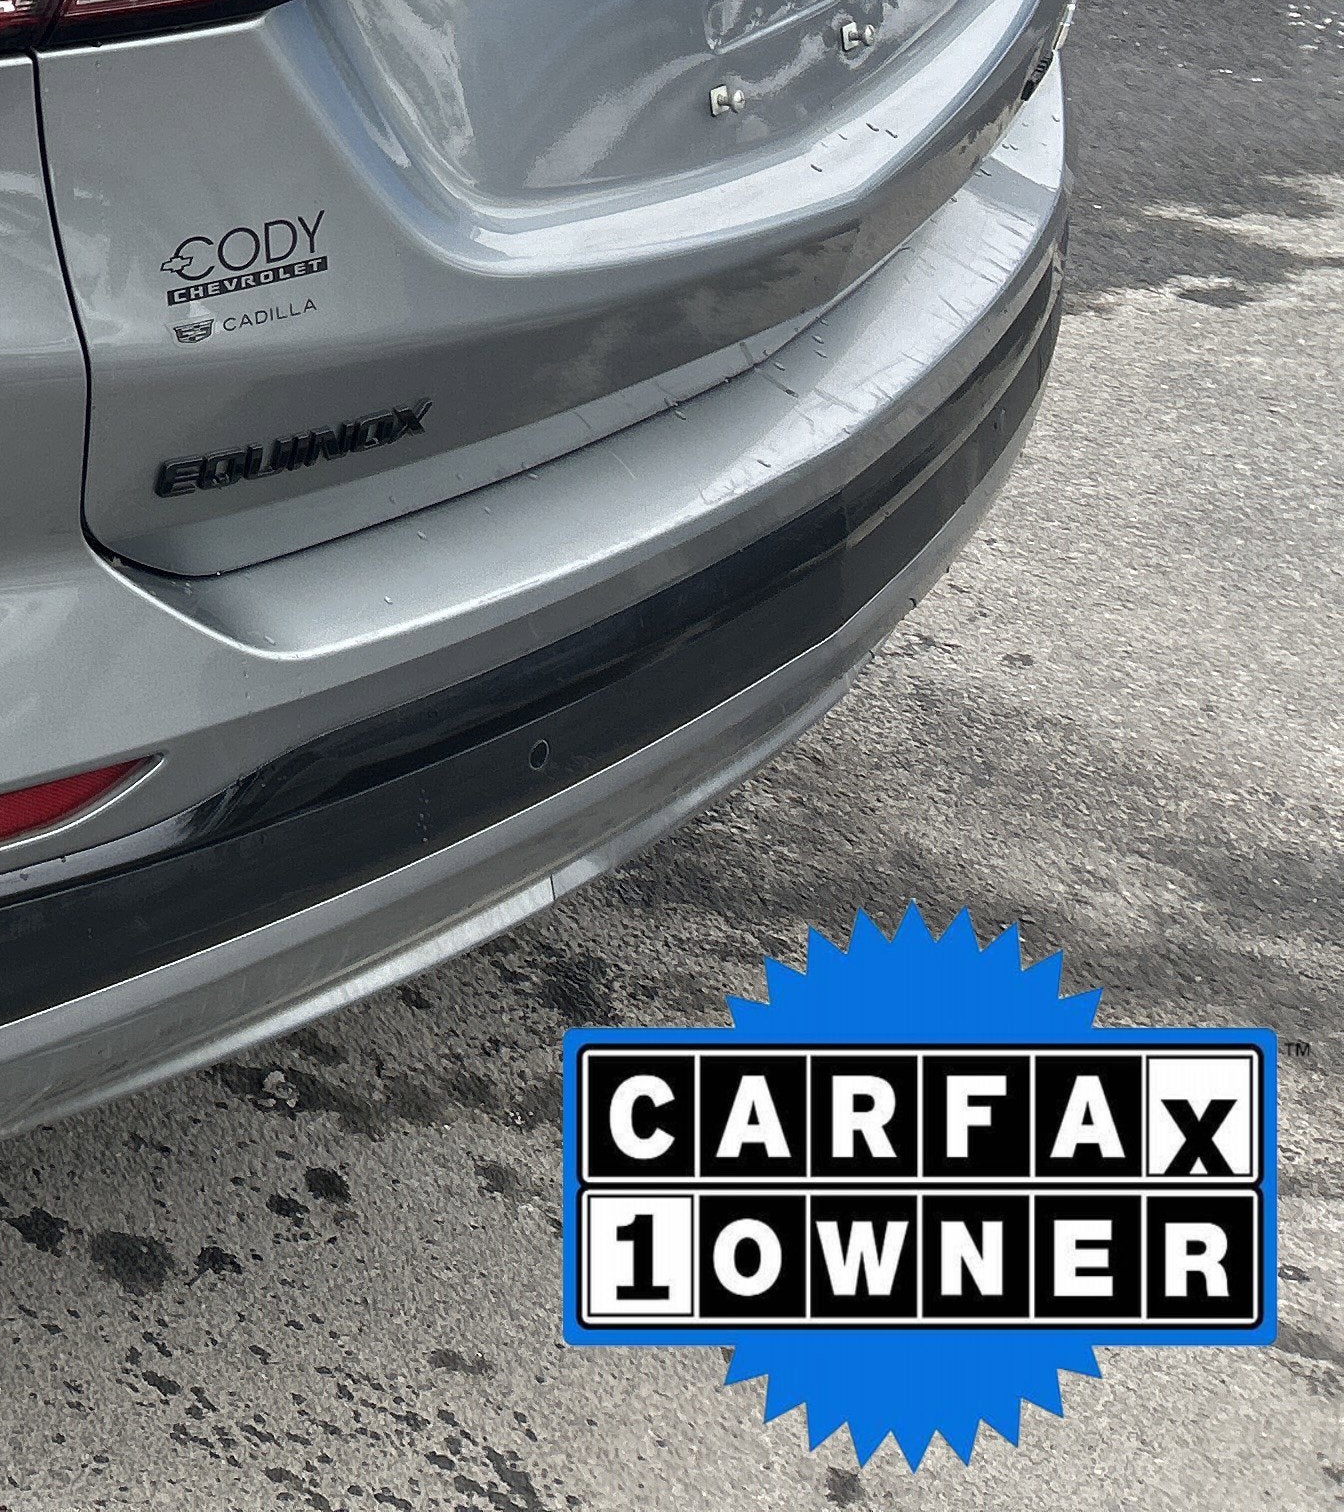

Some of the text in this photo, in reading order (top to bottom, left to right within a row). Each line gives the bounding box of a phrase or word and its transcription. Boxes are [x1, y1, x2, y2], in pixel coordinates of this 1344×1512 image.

[164, 208, 326, 282] CODY
[172, 257, 323, 304] CHEVROLET
[222, 297, 318, 332] CADILLA
[153, 397, 434, 499] EQUINOX
